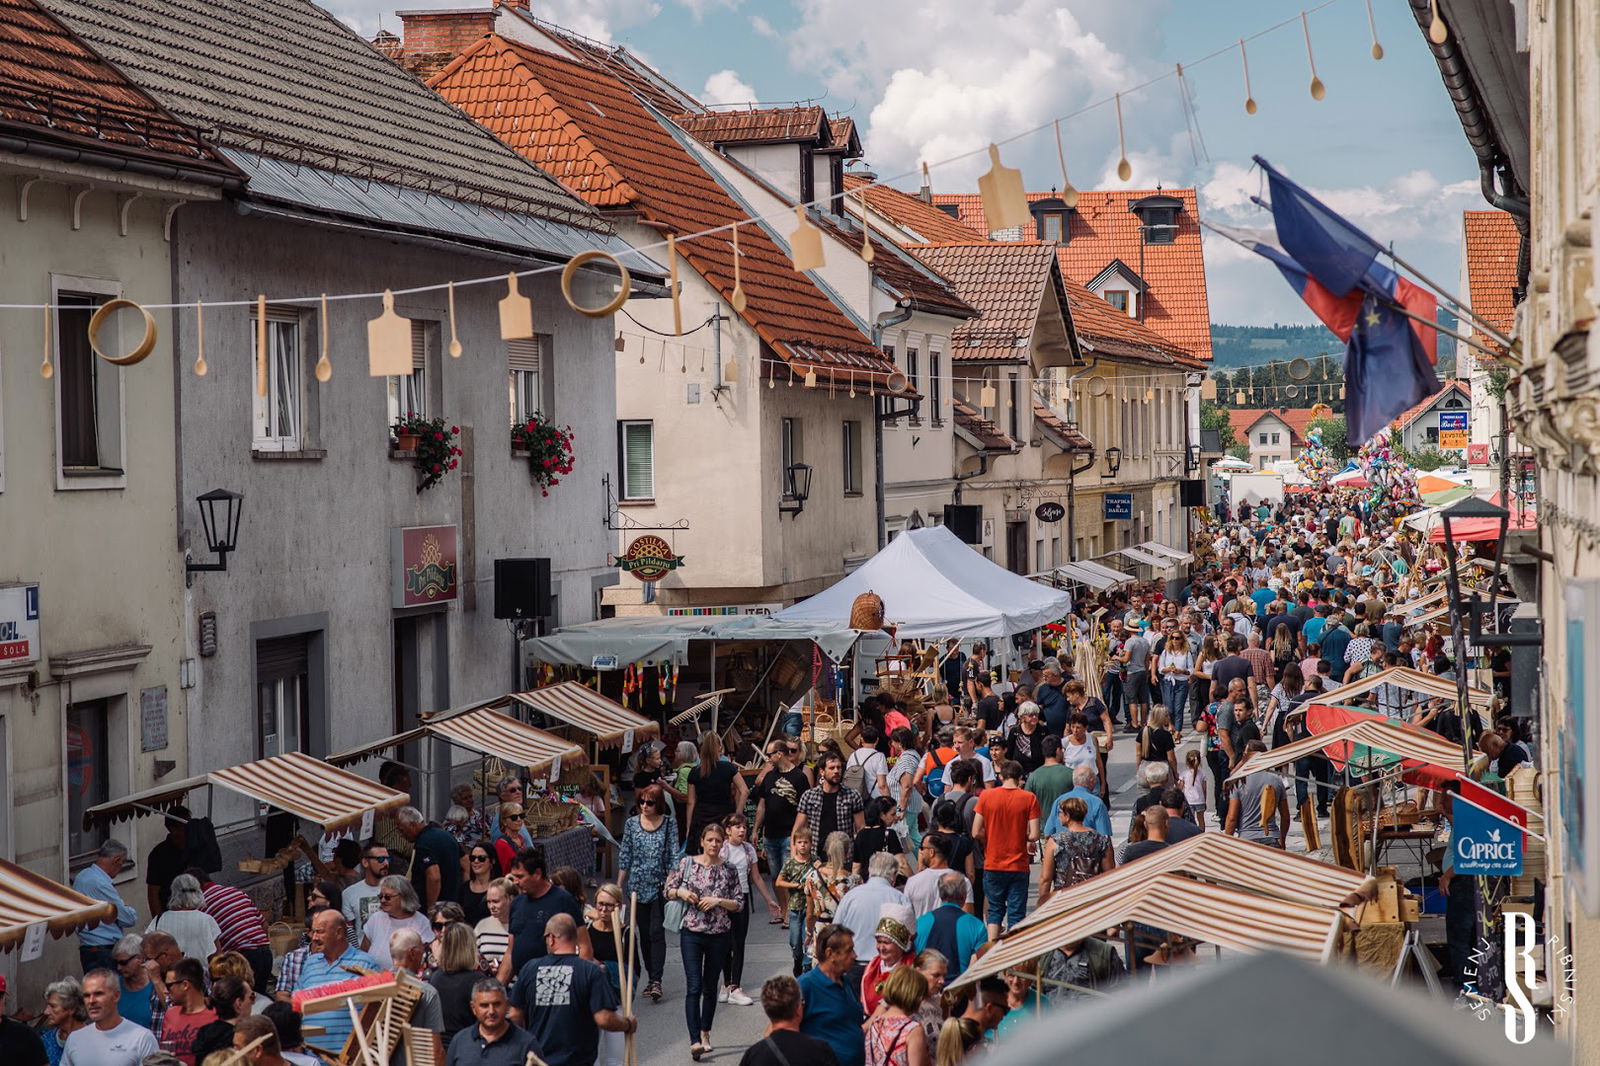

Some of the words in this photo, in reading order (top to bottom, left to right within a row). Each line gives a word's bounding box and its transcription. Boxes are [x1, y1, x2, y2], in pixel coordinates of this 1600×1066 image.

[630, 537, 669, 556] GOSTILNA
[628, 561, 639, 569] Pri
[28, 591, 37, 616] L
[1458, 836, 1516, 859] CAPRICE
